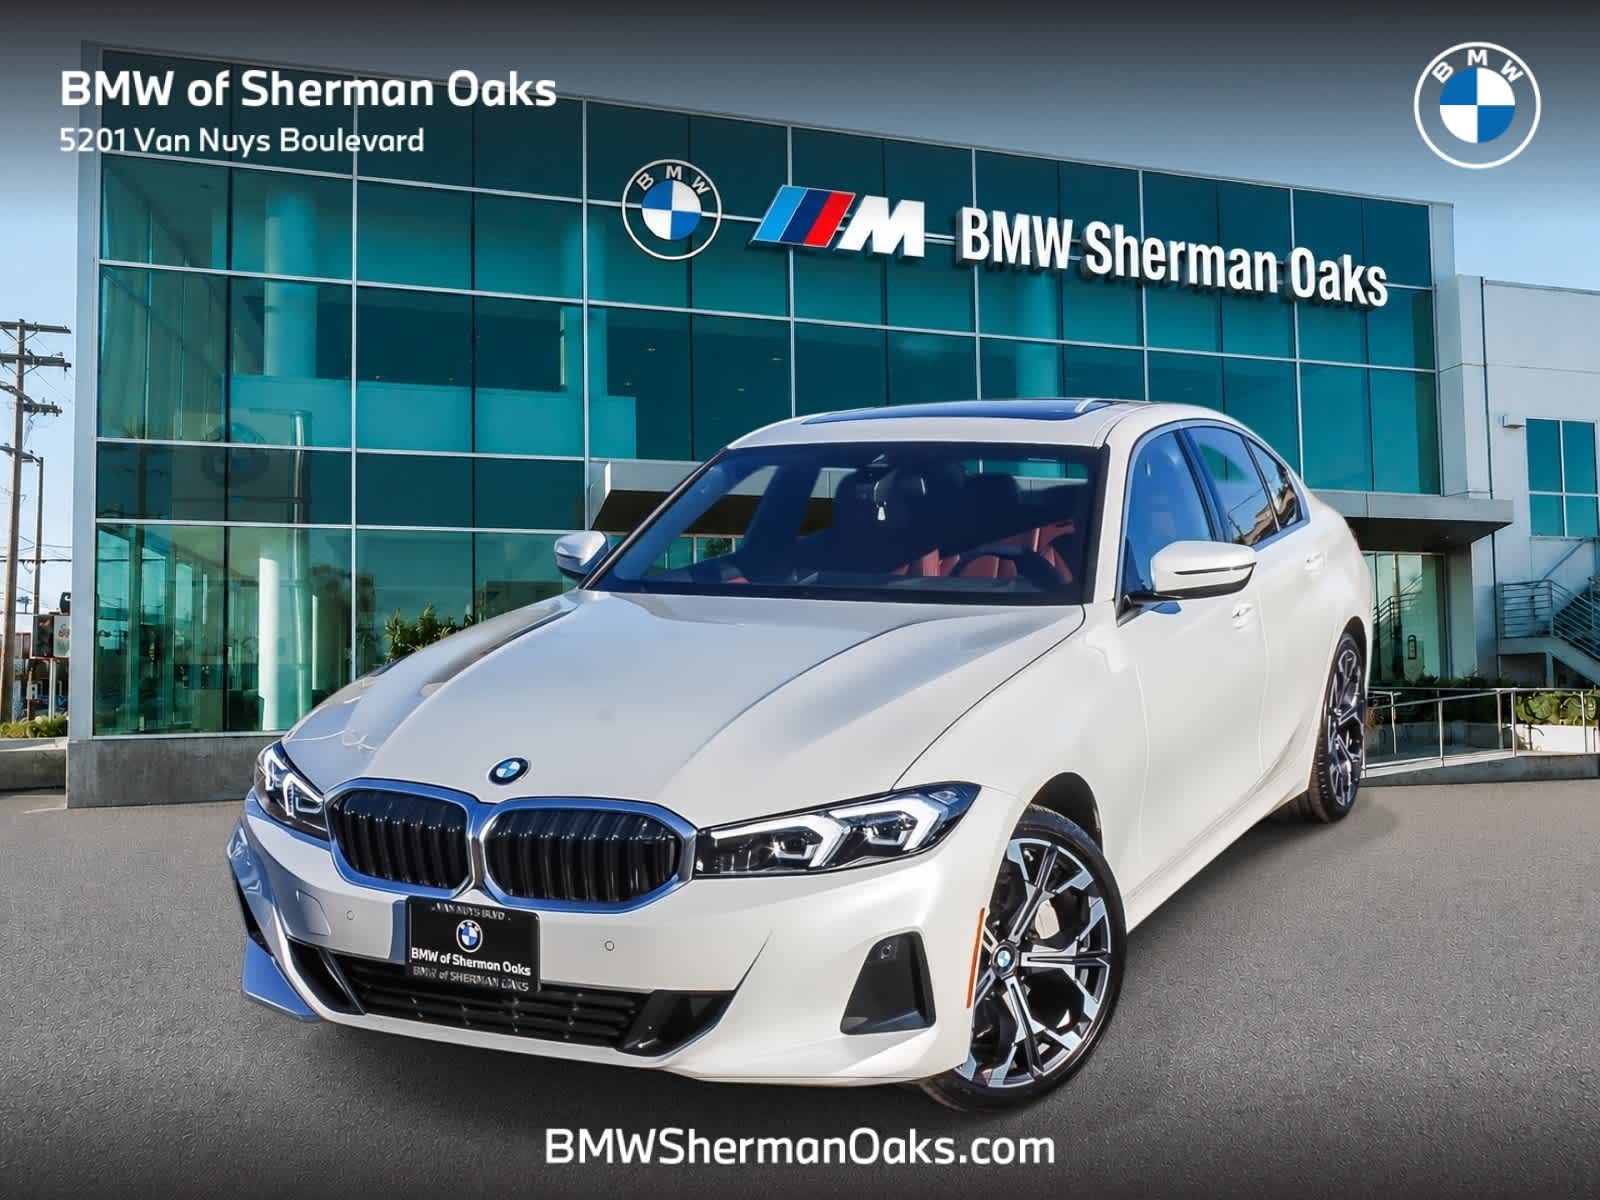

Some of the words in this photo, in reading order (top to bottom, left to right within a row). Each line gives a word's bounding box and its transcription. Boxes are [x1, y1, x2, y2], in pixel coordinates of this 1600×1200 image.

[636, 165, 711, 195] BMW
[960, 206, 1074, 270] BMW
[1083, 220, 1278, 295] Sherman
[1289, 246, 1389, 308] Oaks
[411, 947, 439, 962] BMW
[440, 952, 452, 964] of
[452, 954, 501, 972] Sherman
[502, 961, 532, 977] Oaks
[439, 970, 449, 981] of
[450, 971, 499, 987] SHERMAN
